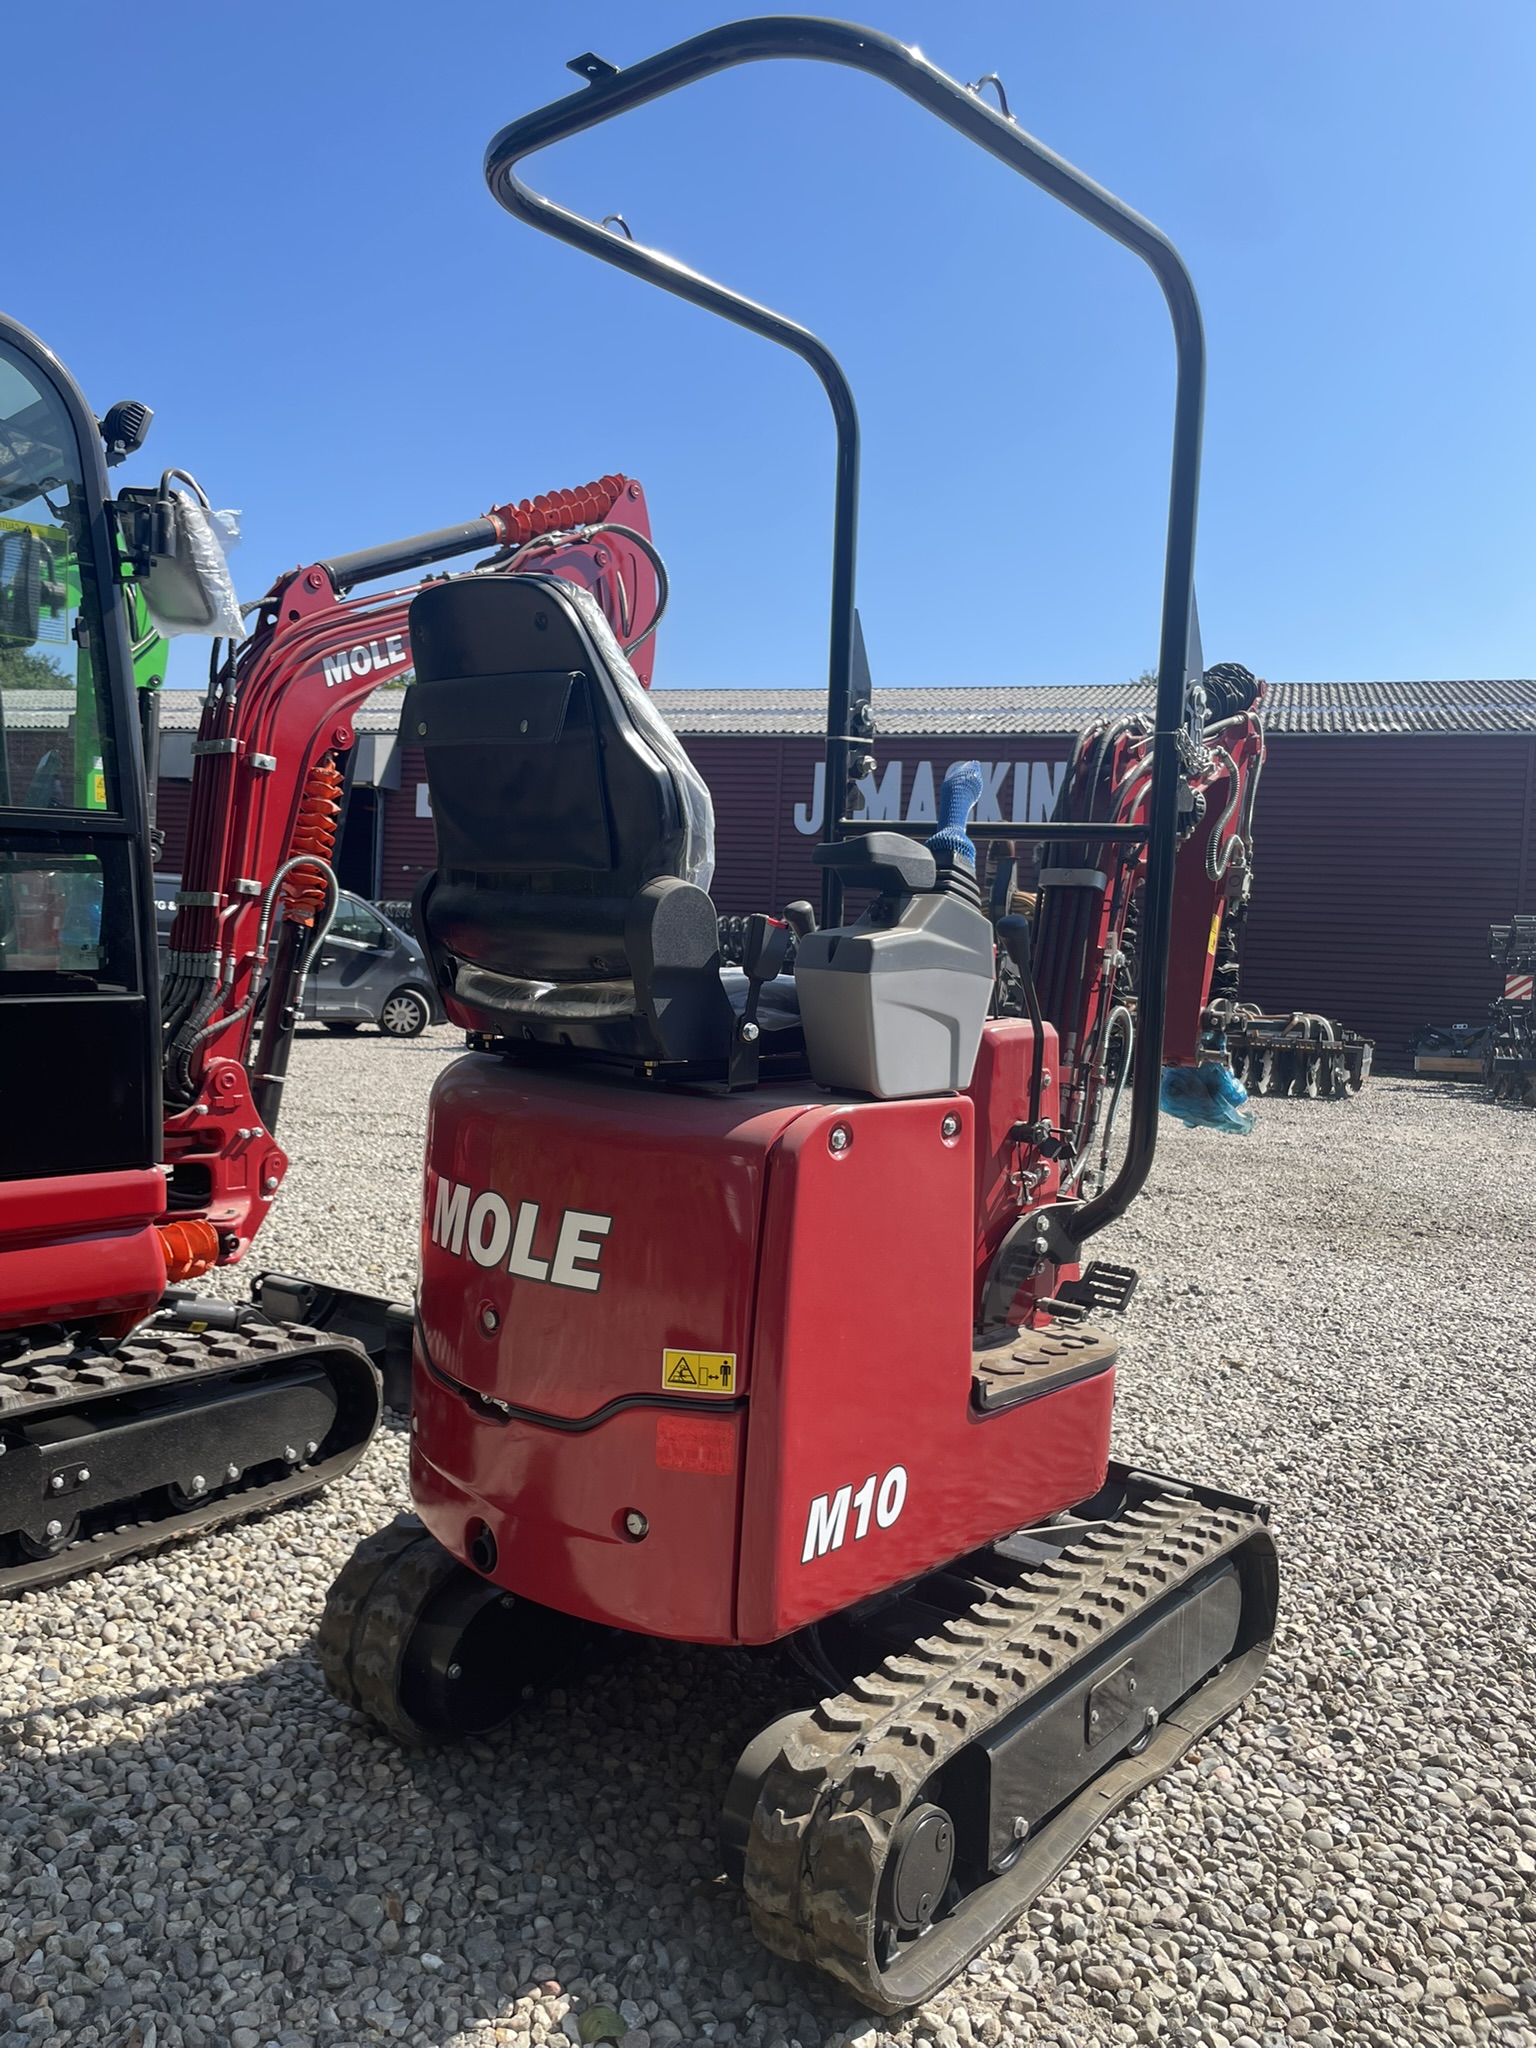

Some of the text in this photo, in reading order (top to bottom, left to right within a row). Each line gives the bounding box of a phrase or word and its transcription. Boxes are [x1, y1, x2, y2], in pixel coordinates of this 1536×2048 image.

[322, 634, 407, 687] MOLE
[852, 760, 1068, 822] MAKIN
[431, 1175, 613, 1292] MOLE
[800, 1464, 908, 1565] M10
